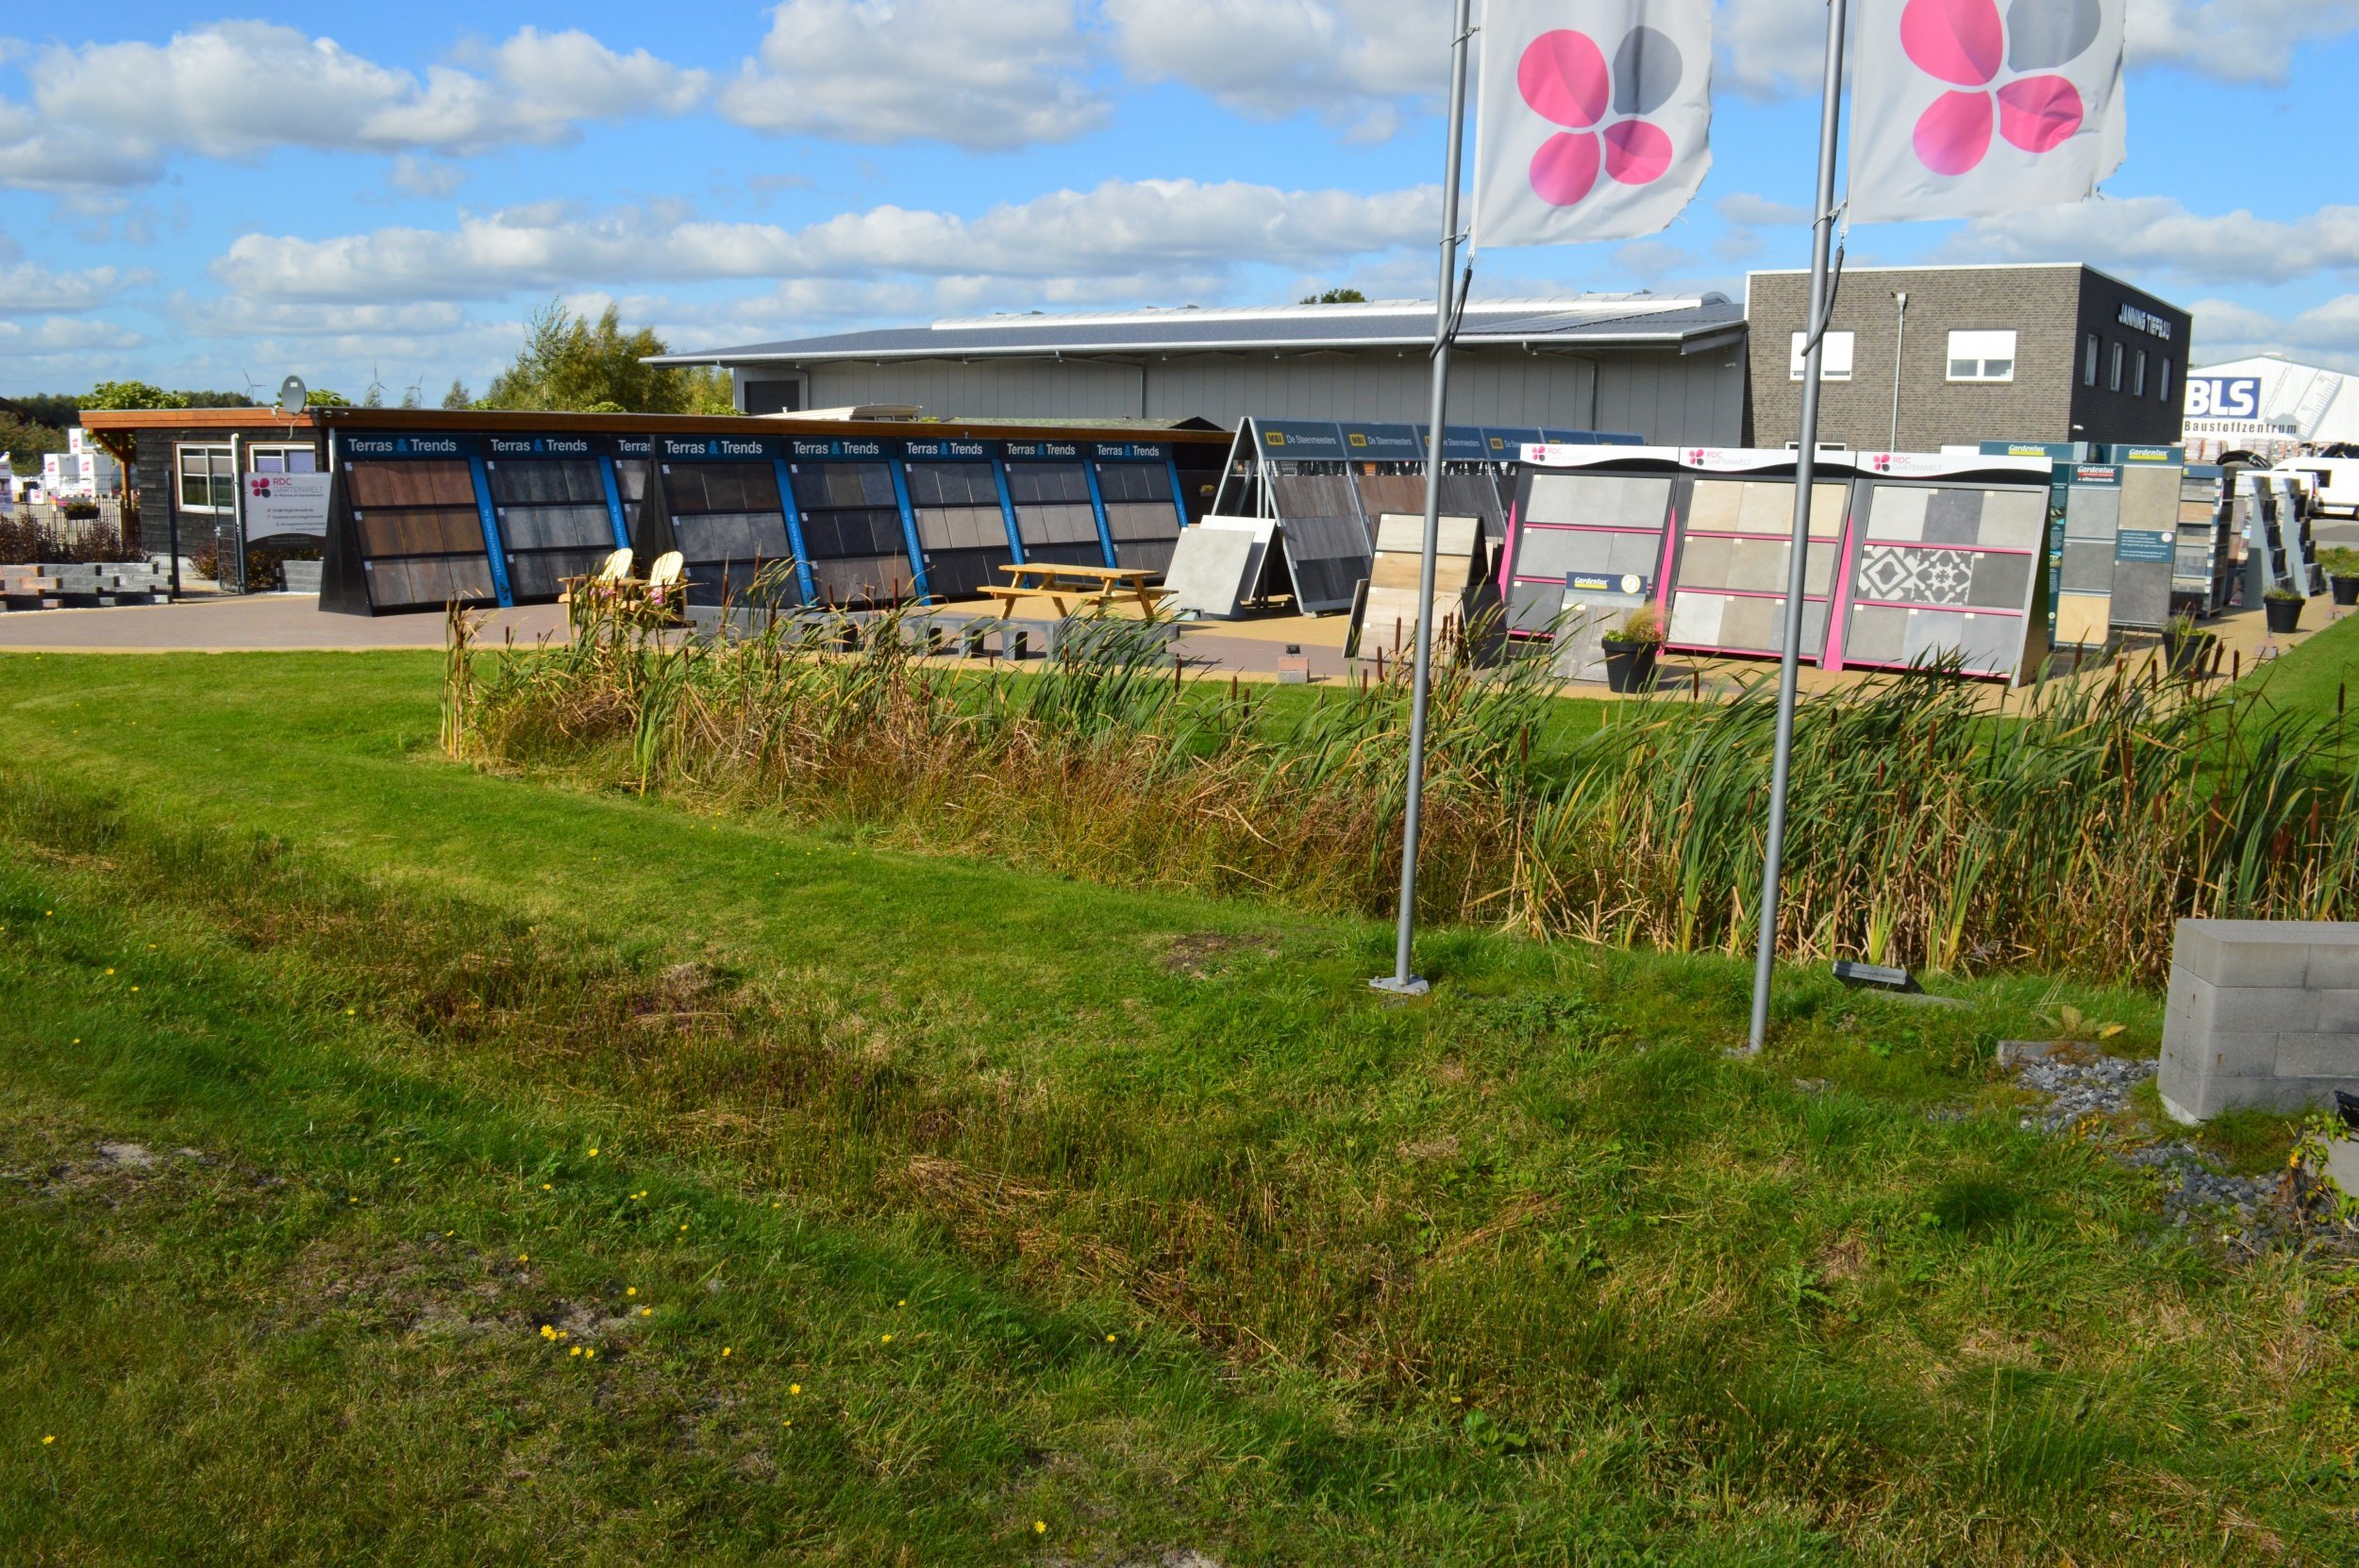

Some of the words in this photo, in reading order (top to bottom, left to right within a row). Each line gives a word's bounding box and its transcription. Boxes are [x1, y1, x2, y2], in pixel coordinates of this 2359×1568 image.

[2118, 303, 2147, 331] JANNING
[2147, 313, 2171, 340] TIEFBAU
[2185, 380, 2254, 416] BLS
[2184, 421, 2297, 434] Baustoffzentrum
[348, 439, 393, 452] Terras
[396, 438, 408, 452] &
[410, 439, 457, 452] Trends
[491, 439, 530, 451] Terras
[534, 439, 543, 452] &
[546, 439, 588, 451] Trends
[1268, 434, 1282, 442] MBI
[1286, 435, 1296, 444] De
[1297, 435, 1336, 444] Steenmeesters
[1351, 436, 1364, 444] MBI
[1368, 437, 1377, 445] De
[1378, 437, 1413, 445] Steenmeesters
[665, 441, 705, 454] Terras
[709, 440, 718, 454] &
[721, 441, 762, 454] Trends
[793, 442, 828, 455] Terras
[831, 442, 840, 455] &
[843, 442, 879, 455] Trends
[907, 442, 938, 455] Terras
[940, 442, 948, 455] &
[950, 442, 983, 455] Trends
[1007, 443, 1035, 455] Terras
[1037, 443, 1045, 456] &
[1046, 443, 1076, 456] Trends
[1096, 444, 1123, 456] Terras
[1125, 444, 1131, 457] &
[1132, 445, 1160, 457] Trends
[2008, 444, 2046, 453] Gardenlux
[2129, 448, 2168, 457] Gardenlux
[2077, 465, 2116, 474] Gardenlux
[904, 509, 921, 574] ERRASENTRENDS.NL
[1574, 576, 1608, 585] Gardenlux
